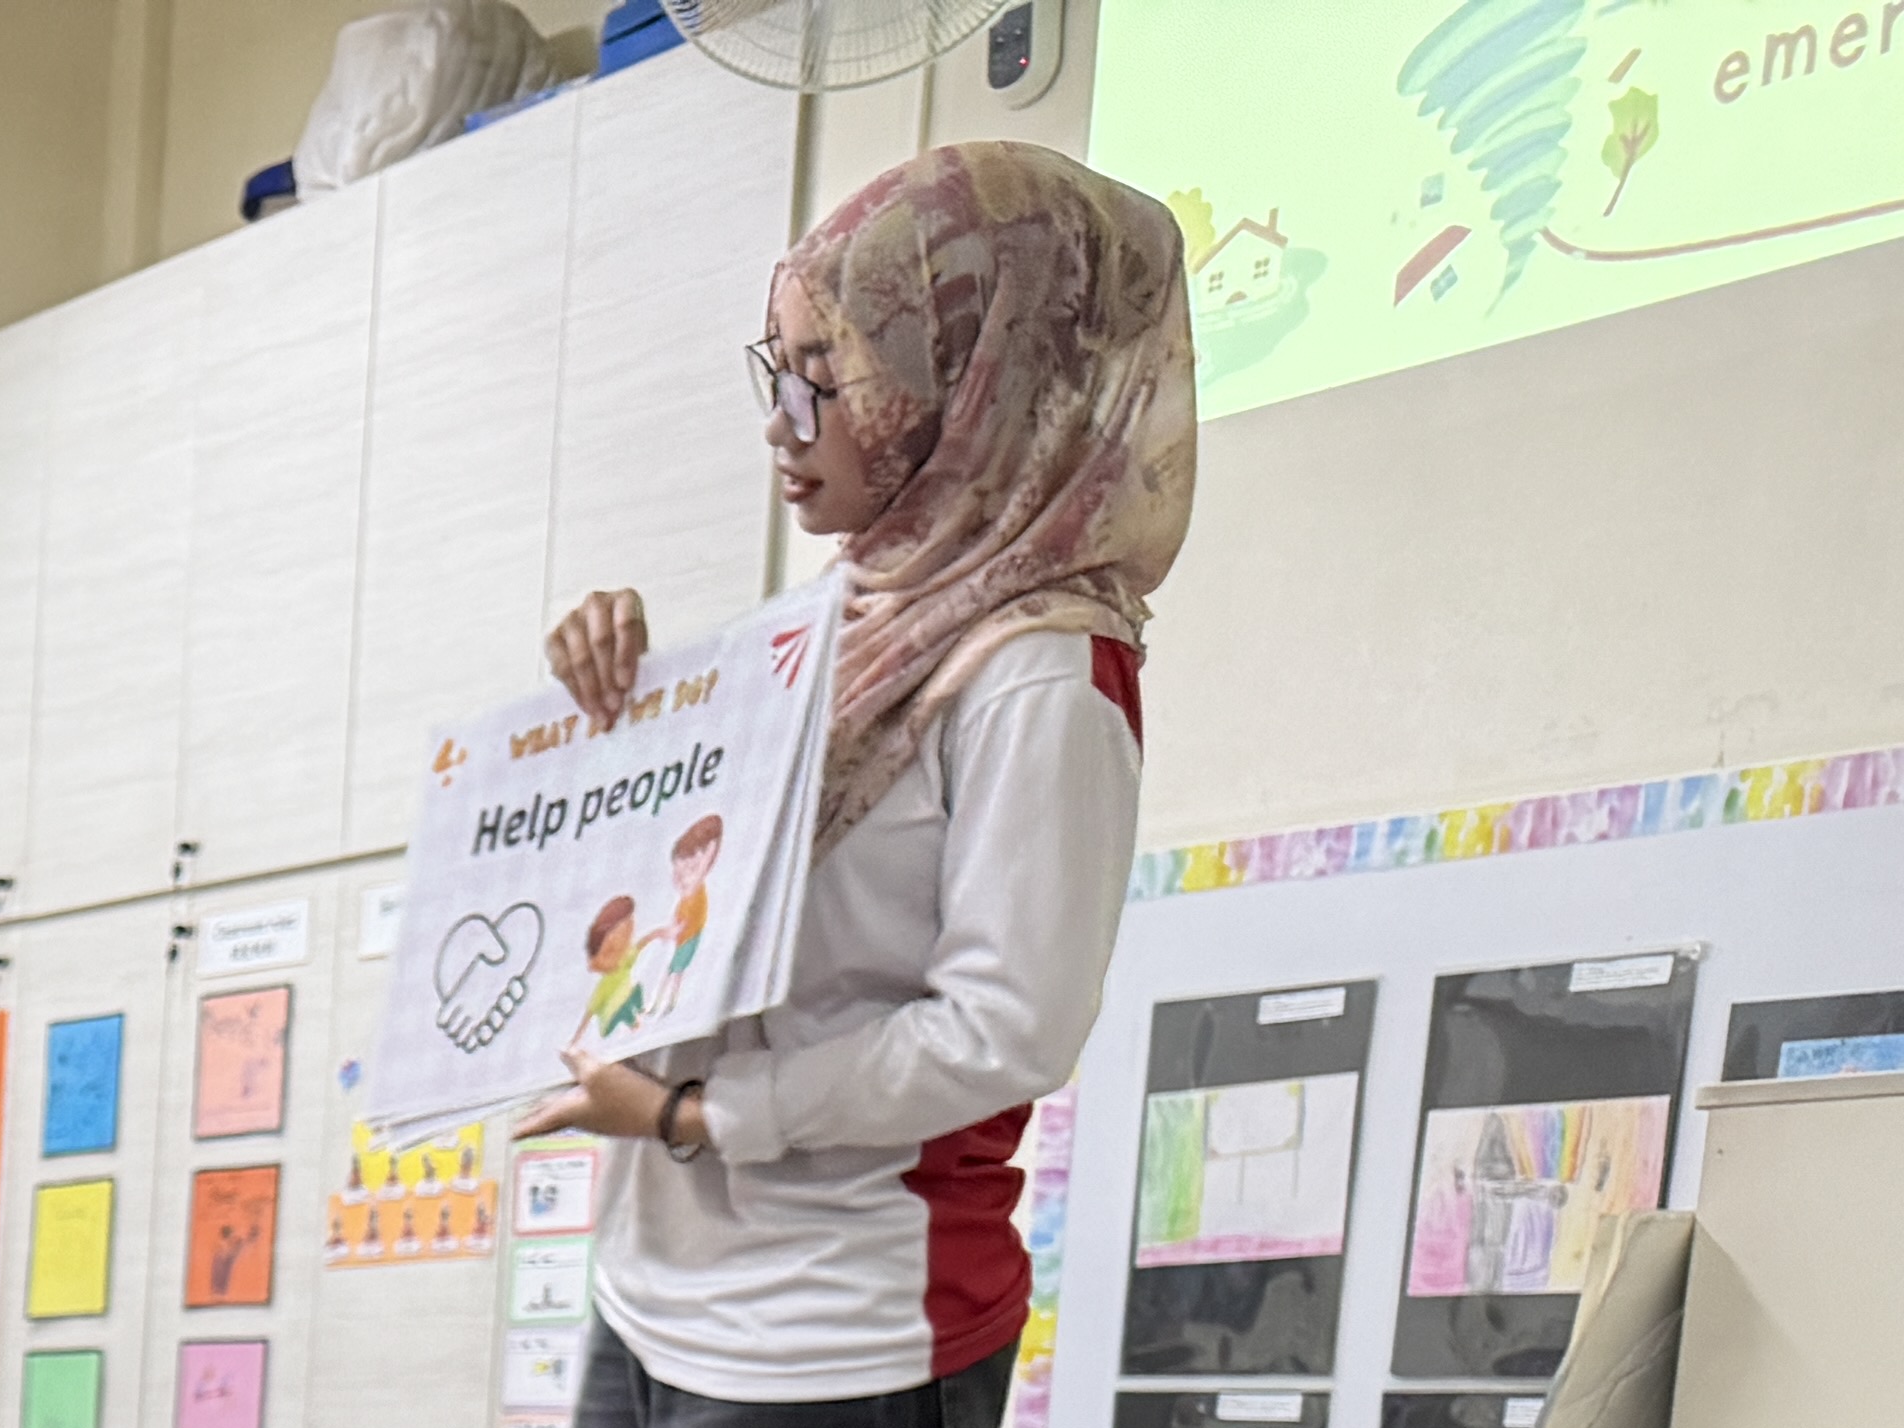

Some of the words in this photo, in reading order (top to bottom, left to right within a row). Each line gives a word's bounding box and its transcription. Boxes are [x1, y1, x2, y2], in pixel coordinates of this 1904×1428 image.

[510, 713, 579, 760] WHAT
[471, 793, 569, 856] Help
[574, 742, 725, 841] people
